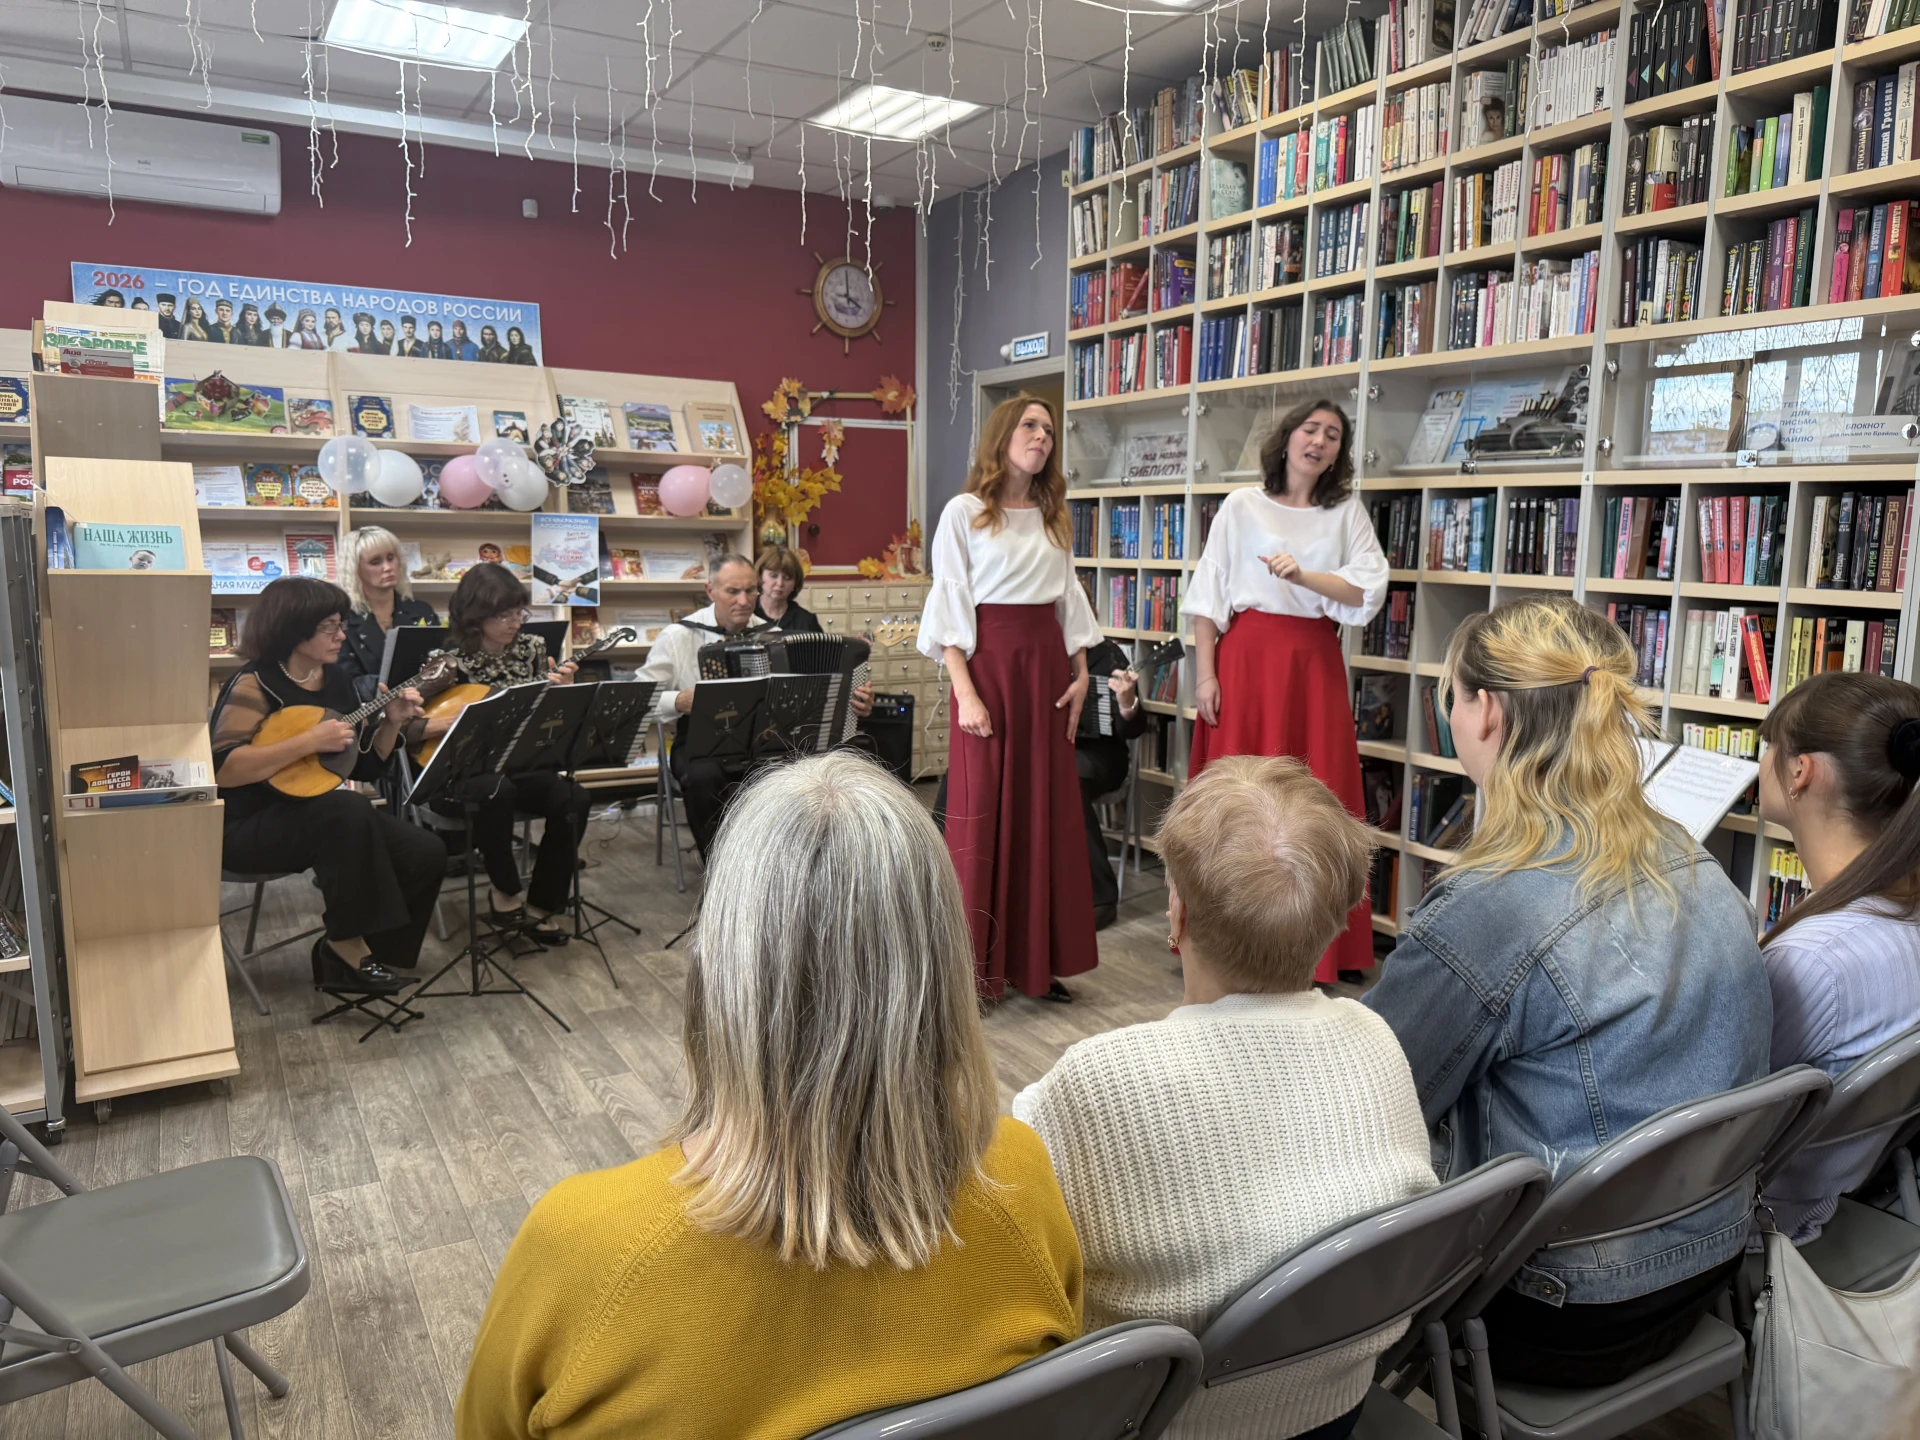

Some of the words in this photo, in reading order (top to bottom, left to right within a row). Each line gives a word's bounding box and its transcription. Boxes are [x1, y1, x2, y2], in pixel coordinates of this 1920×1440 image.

[1881, 81, 1895, 129] Гроссман
[1879, 129, 1893, 167] Василий
[92, 270, 145, 290] 2026
[178, 277, 224, 298] ГОД
[228, 282, 336, 306] ЕДИНСТВА
[342, 292, 438, 316] НАРОДОВ
[443, 302, 523, 323] РОССИИ
[1640, 308, 1648, 323] Д
[1015, 337, 1045, 355] ВЫХОД
[1791, 410, 1811, 418] ДЛЯ
[1780, 418, 1818, 426] ПИСЬМА
[1845, 422, 1886, 430] БЛОКНОТ
[1780, 435, 1814, 443] РАЙЛЮ
[83, 528, 125, 543] НАША
[127, 530, 173, 544] ЖИЗНЬ
[1868, 550, 1878, 577] ОСТРОВ
[91, 775, 131, 787] ДОНБАССА
[106, 769, 131, 779] ГЕРОИ
